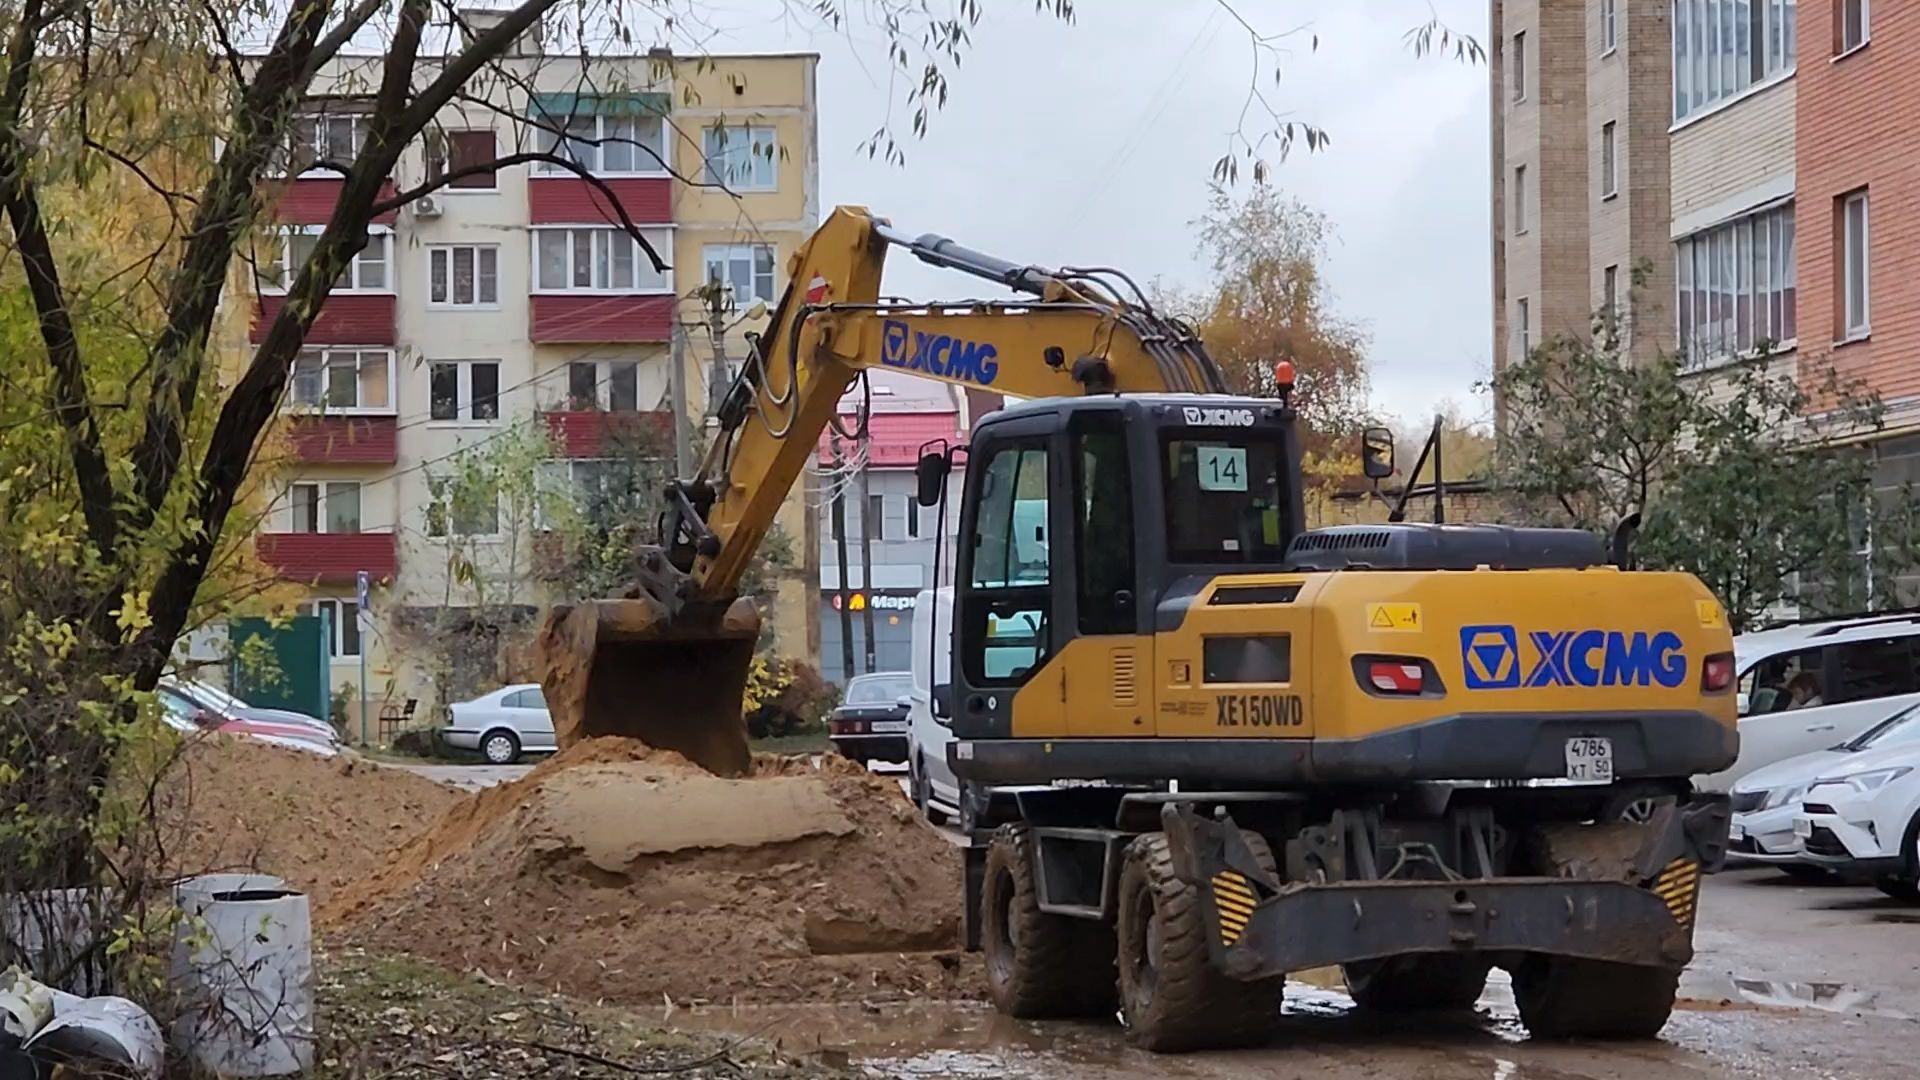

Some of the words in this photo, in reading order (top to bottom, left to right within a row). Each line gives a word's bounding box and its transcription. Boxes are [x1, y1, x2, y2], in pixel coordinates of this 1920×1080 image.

[907, 331, 998, 385] XCMG
[1201, 409, 1254, 427] XCMG
[1209, 455, 1239, 483] 14
[1522, 629, 1687, 688] XCMG
[1216, 695, 1303, 727] XE150WD
[1572, 739, 1606, 756] 4786
[1595, 760, 1609, 773] 50
